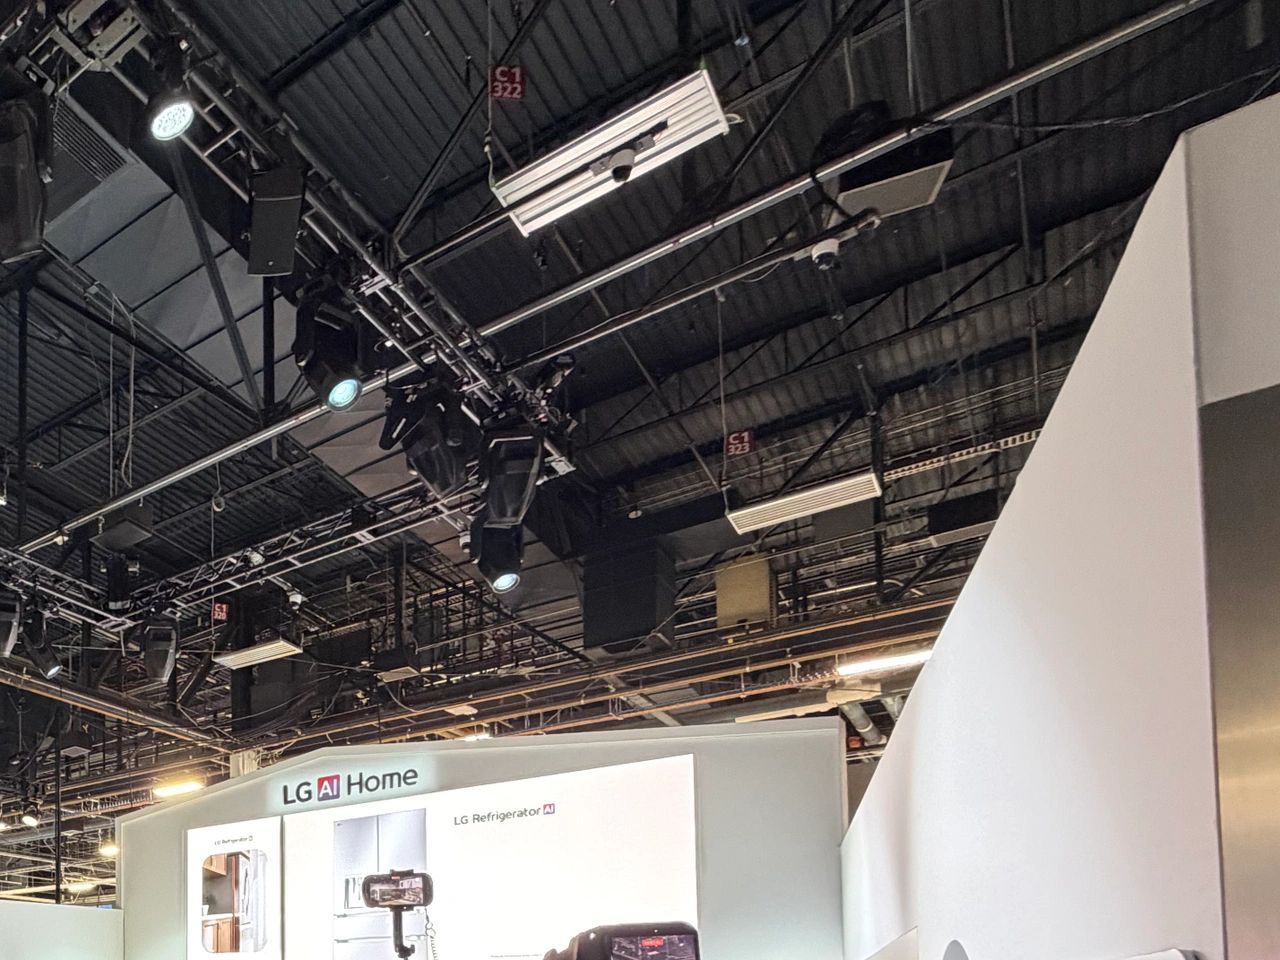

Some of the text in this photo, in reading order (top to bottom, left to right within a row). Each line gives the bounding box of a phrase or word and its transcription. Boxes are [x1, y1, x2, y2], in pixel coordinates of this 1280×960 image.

[495, 66, 521, 81] C1
[492, 82, 521, 98] 322
[729, 431, 749, 443] C1
[728, 443, 750, 455] 323
[282, 768, 419, 805] LG AI Home
[454, 815, 469, 826] LG
[472, 807, 541, 823] Refrigerator
